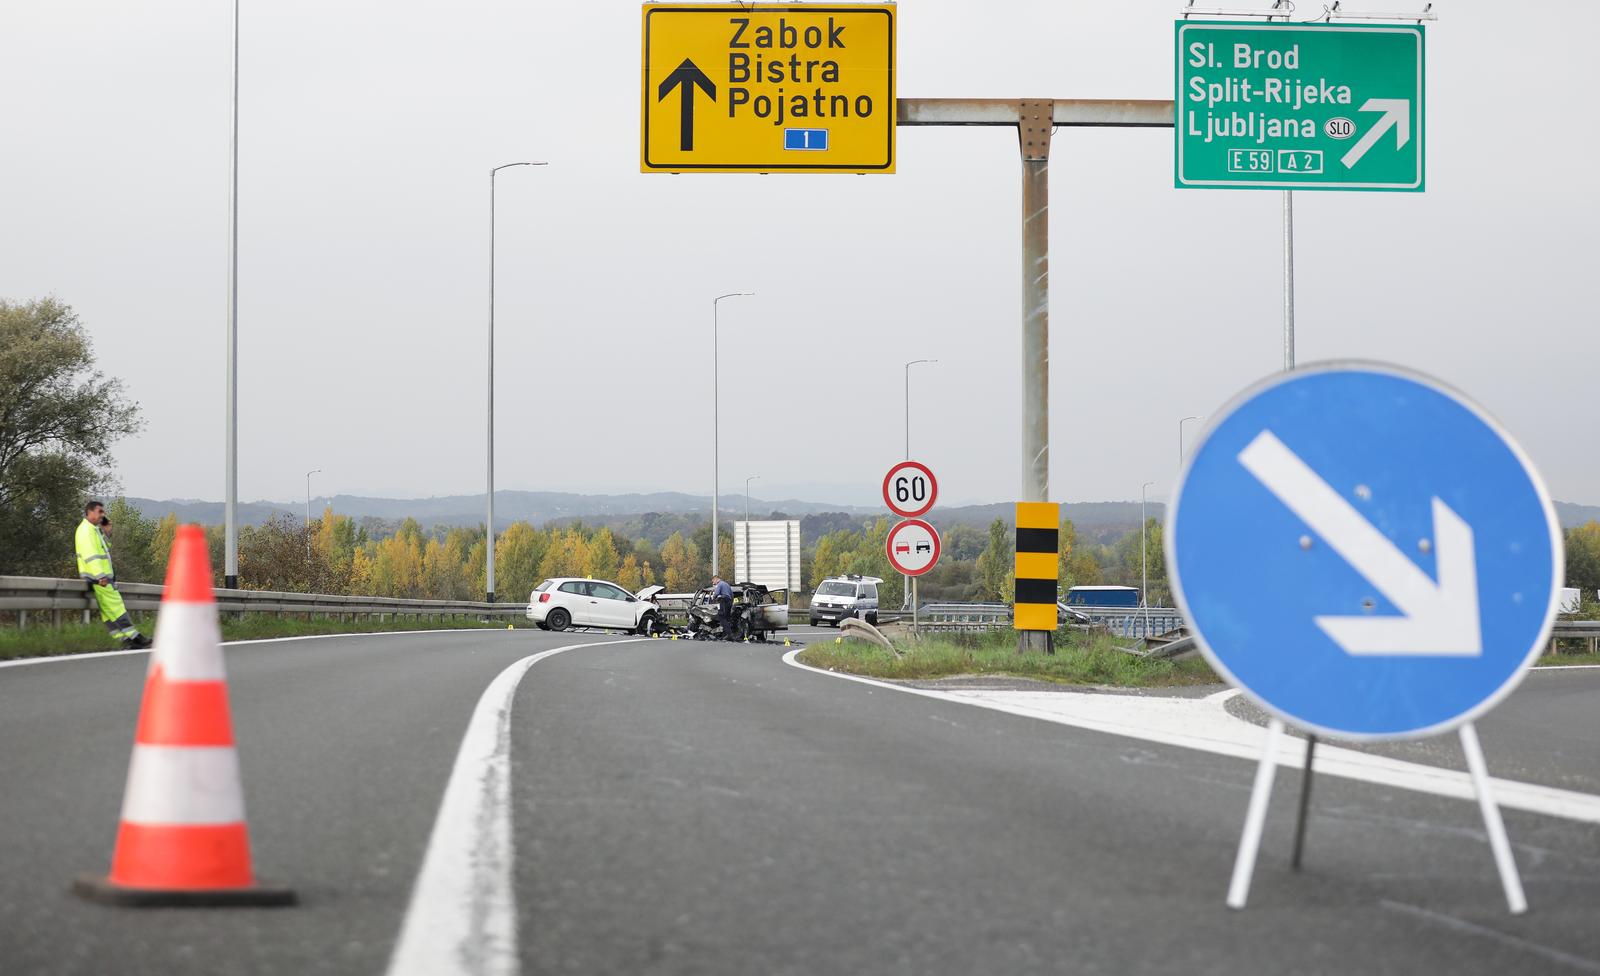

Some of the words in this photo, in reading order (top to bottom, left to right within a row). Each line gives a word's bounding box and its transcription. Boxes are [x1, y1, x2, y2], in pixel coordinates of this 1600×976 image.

[729, 17, 846, 49] Zabok
[729, 53, 839, 83] Bistra
[1188, 42, 1222, 68] Sl.
[1233, 43, 1299, 69] Brod
[728, 87, 873, 126] Pojatno
[1188, 76, 1352, 110] Split-Rijeka
[1188, 110, 1316, 144] Ljubljana
[1329, 121, 1350, 136] SLO
[1233, 151, 1243, 169] E
[1249, 152, 1270, 170] 59
[1287, 154, 1298, 169] A
[1304, 155, 1313, 170] 2
[895, 475, 926, 503] 60
